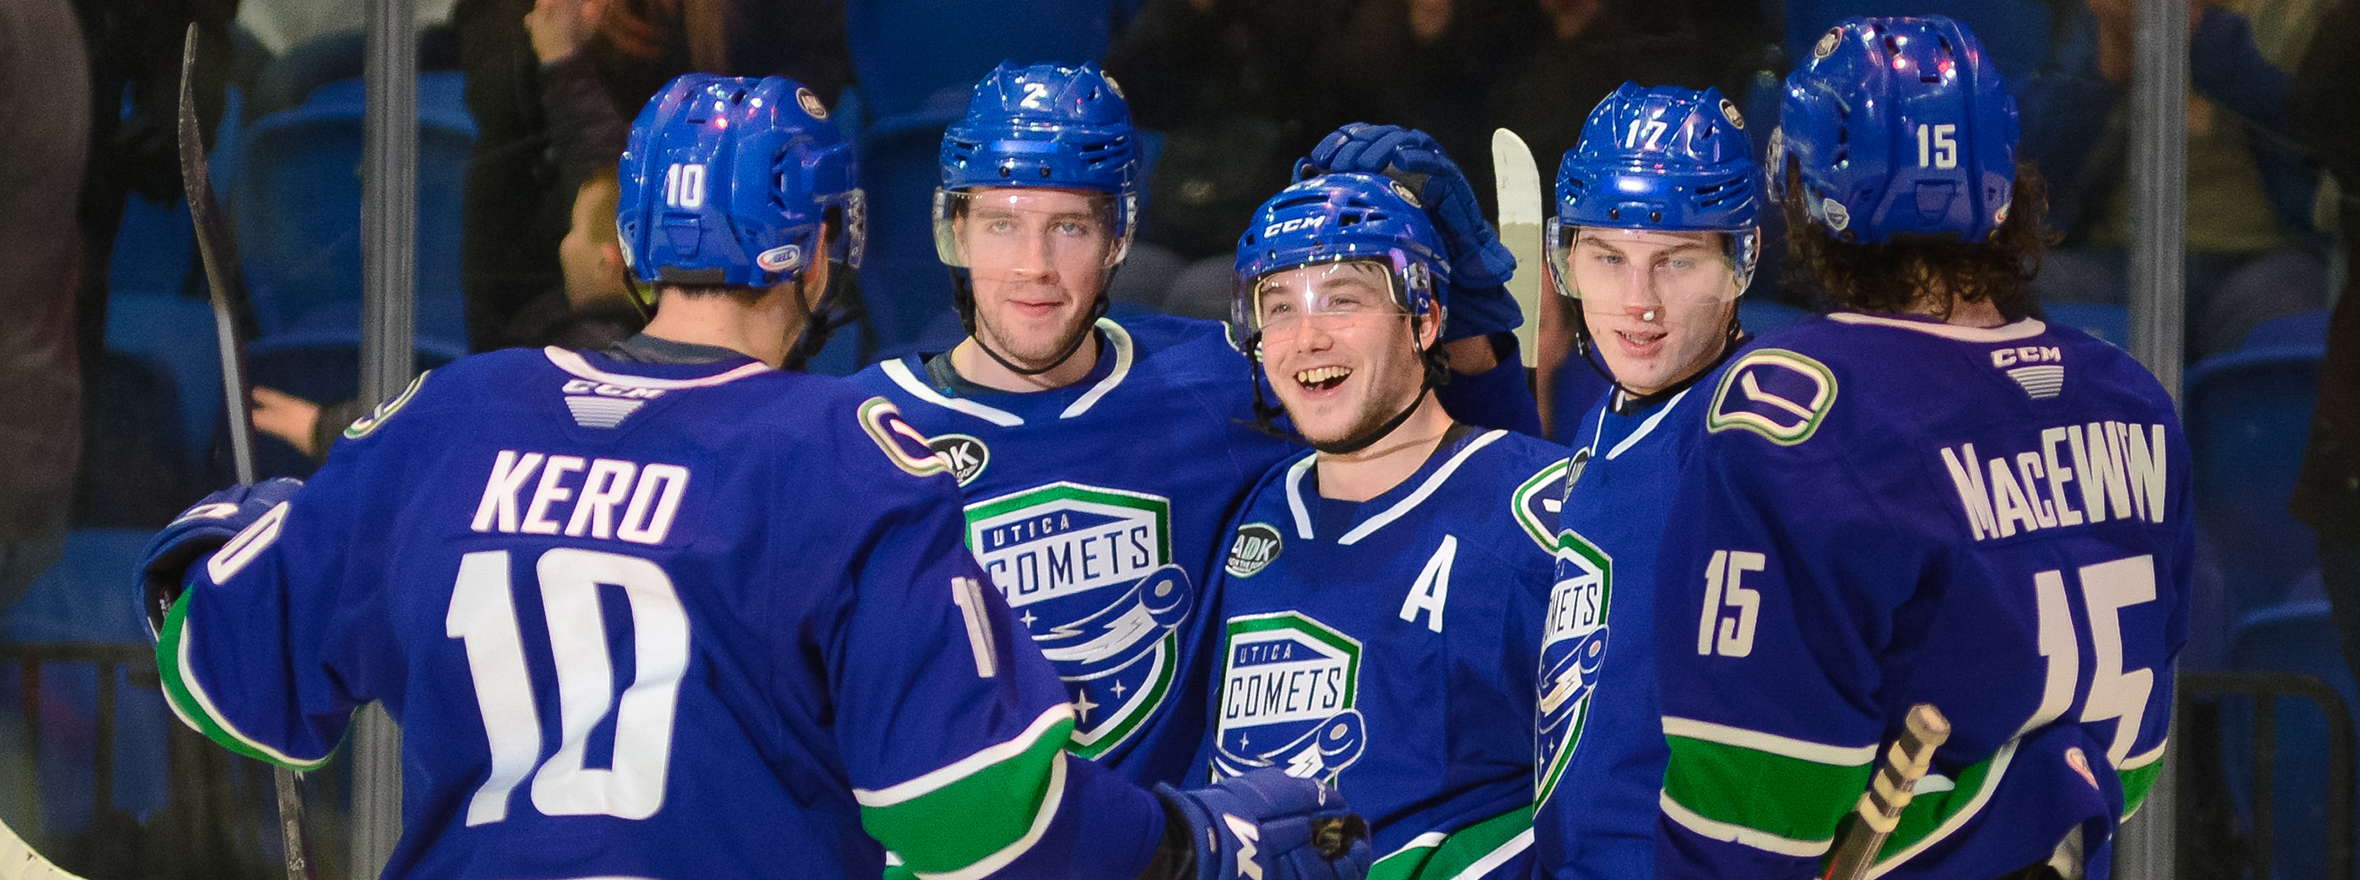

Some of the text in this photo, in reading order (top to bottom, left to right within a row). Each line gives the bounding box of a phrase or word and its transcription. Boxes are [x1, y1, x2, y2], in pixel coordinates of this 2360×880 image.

[1020, 82, 1047, 109] 2
[1625, 119, 1667, 151] 17
[1917, 123, 1957, 169] 15
[666, 163, 705, 209] 10
[1264, 215, 1326, 239] CCM
[1990, 346, 2062, 369] CCM
[562, 379, 667, 399] CCM
[470, 450, 691, 545] KERO
[207, 500, 289, 586] 0
[993, 513, 1070, 547] UTICA
[1230, 533, 1278, 562] ADK
[985, 525, 1150, 602] COMETS
[1399, 533, 1458, 634] A
[1698, 550, 1766, 658] 15
[1239, 643, 1292, 664] UTICA
[2014, 554, 2157, 770] 15
[446, 547, 691, 827] 10
[1226, 666, 1341, 720] COMETS
